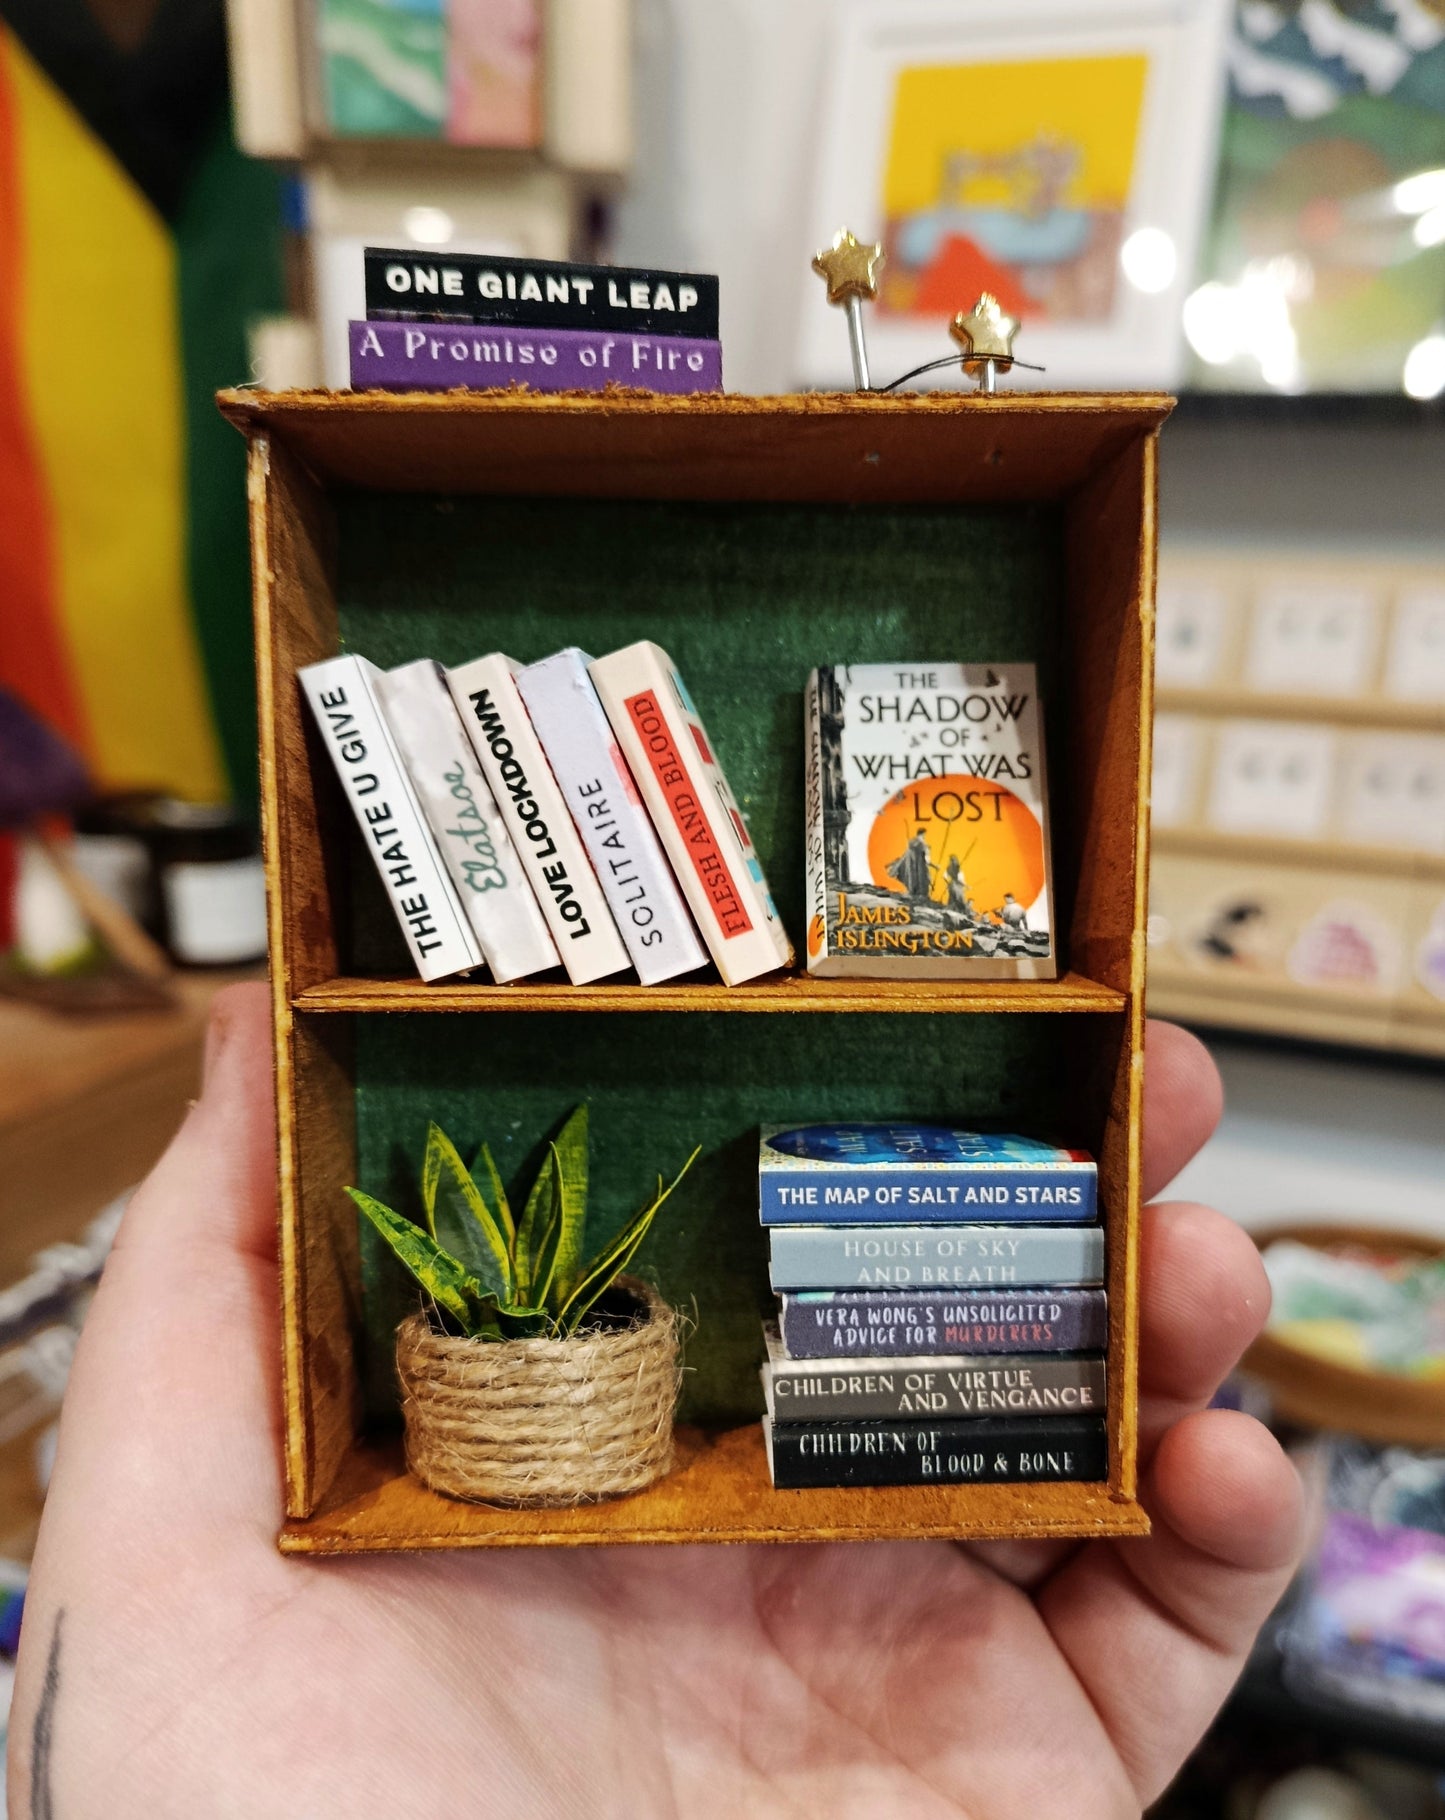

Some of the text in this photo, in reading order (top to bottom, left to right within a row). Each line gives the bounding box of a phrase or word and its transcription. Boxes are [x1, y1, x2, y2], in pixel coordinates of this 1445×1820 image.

[385, 264, 699, 312] ONE GIANT LEAP
[359, 327, 704, 372] A Promise of Fire
[896, 672, 938, 689] THE
[859, 695, 1029, 723] SHADOW
[939, 728, 970, 748] OF
[852, 753, 1032, 779] WHAT WAS
[469, 689, 591, 939] LOVE LOCKDOWN
[634, 697, 744, 934] FLESH AND BLOOD
[913, 791, 1010, 822] LOST
[320, 686, 443, 958] THE HATE U GIVE
[578, 778, 662, 946] SOLITAIRE
[837, 892, 911, 925] JAMES
[837, 929, 973, 953] ISLINGTON
[778, 1186, 1081, 1204] THE MAP OF SALT AND STARS
[844, 1240, 1021, 1257] HOUSE OF SKY
[858, 1265, 1016, 1283] AND BREATH
[815, 1304, 1062, 1327] VERA WONG'S UNSOLICITED
[833, 1324, 1054, 1347] ADVICE FOR MURDERERS
[775, 1370, 1032, 1396] CHILDREN OF VIRTUE
[898, 1386, 1094, 1412] AND VENGANCE
[799, 1431, 941, 1454] CHILDREN OF
[921, 1451, 1075, 1474] BLOOD & BONE
